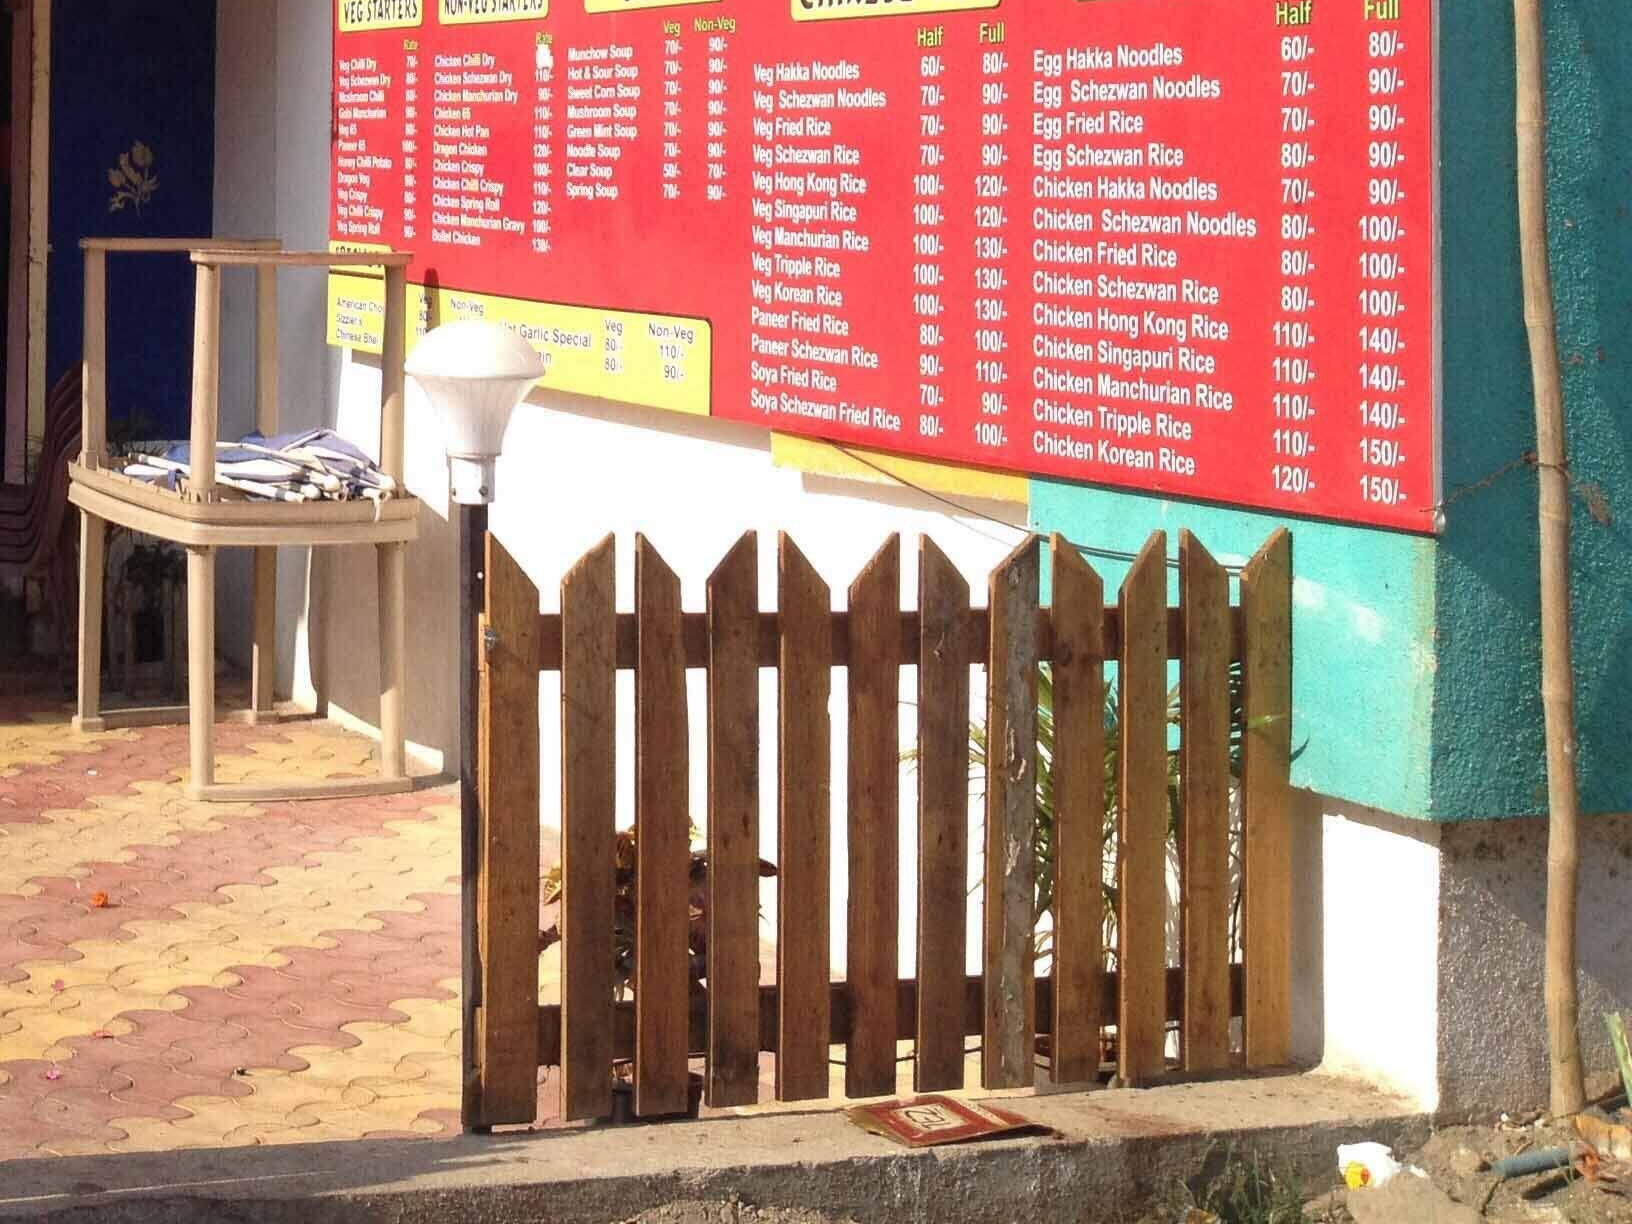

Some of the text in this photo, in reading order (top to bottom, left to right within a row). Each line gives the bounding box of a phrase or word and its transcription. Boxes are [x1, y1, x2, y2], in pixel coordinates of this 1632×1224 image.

[344, 0, 364, 24] VEG
[1276, 0, 1311, 24] Half
[918, 22, 1004, 46] Half Full
[1034, 31, 1403, 77] Egg Hakka Noodles 60/- 80/-
[754, 61, 859, 87] Veg Hakka Noodles
[1034, 68, 1404, 108] Egg Schezwan Noodles 70/- 90/-
[754, 88, 886, 113] Veg Schezwan Noodles
[753, 117, 831, 141] Veg Fried Rice
[1034, 104, 1404, 140] Egg Fried Rice 70/- 90/-
[753, 144, 859, 168] Veg Schezwan Rice
[1033, 142, 1404, 172] Egg Schezwan Rice 80/- 90/-
[752, 171, 867, 197] Veg Hong Kong Rice
[1034, 176, 1404, 205] Chicken Hakka Noodles 70/- 90/-
[752, 198, 856, 224] Veg Singapuri Rice
[1033, 207, 1404, 242] Chicken Schezwan Noodles 80/- 100/-
[752, 226, 869, 251] Veg Manchurian Rice
[752, 252, 840, 278] Veg Tripple Rice
[1033, 239, 1404, 280] Chicken Fried Rice 80/- 100/-
[752, 280, 842, 307] Veg Korean Rice
[1033, 271, 1404, 317] Chicken Schezwan Rice 80/- 100/-
[605, 319, 694, 344] Veg Non-Veg
[752, 306, 848, 336] Paneer Fried Rice
[1034, 303, 1405, 354] Chicken Hong Kong Rice 110/- 140/-
[520, 324, 549, 342] Garlic
[552, 328, 592, 348] Special
[752, 333, 878, 368] Paneer Schezwan Rice
[659, 345, 685, 359] 110/-
[1033, 334, 1405, 392] Chicken Singapuri Rice 110/- 140/-
[664, 364, 684, 379] 90/-
[751, 361, 837, 392] Soya Fried Rice
[751, 388, 901, 431] Soya Schezwan Fried Rice
[1033, 366, 1405, 429] Chicken Manchurian Rice 110/- 140/-
[1033, 398, 1405, 467] Chicken Tripple Rice 110/- 150/-
[1034, 431, 1406, 505] Chicken Korean Rice 120/- 150/-
